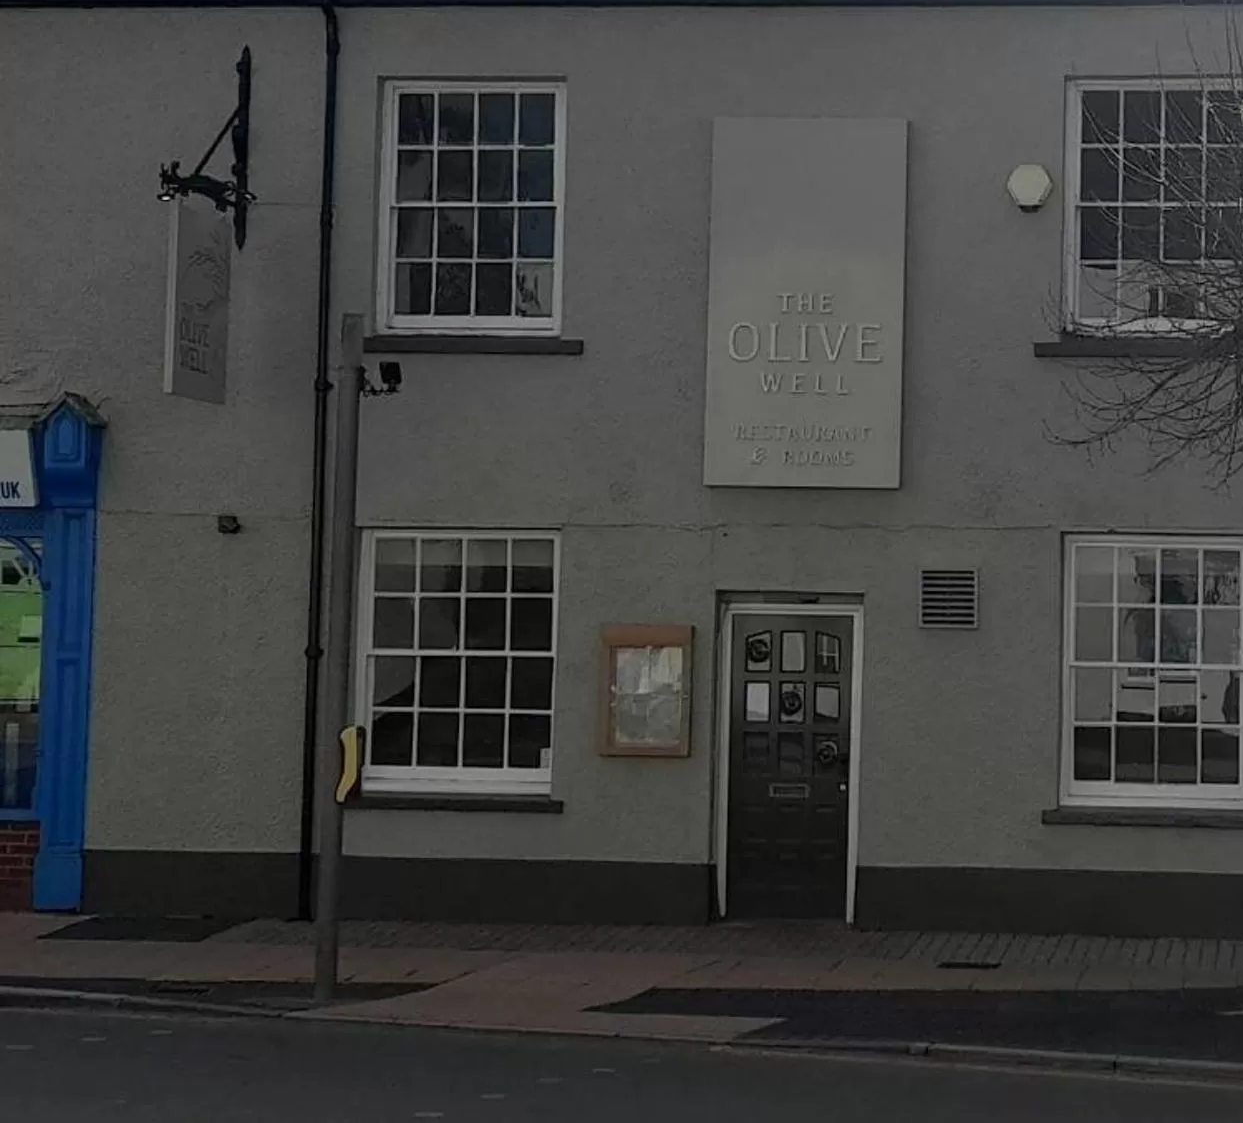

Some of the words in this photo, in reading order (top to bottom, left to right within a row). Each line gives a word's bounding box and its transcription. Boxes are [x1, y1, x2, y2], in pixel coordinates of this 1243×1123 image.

[777, 292, 835, 314] THE
[728, 321, 883, 363] OLIVE
[760, 372, 851, 396] WELL
